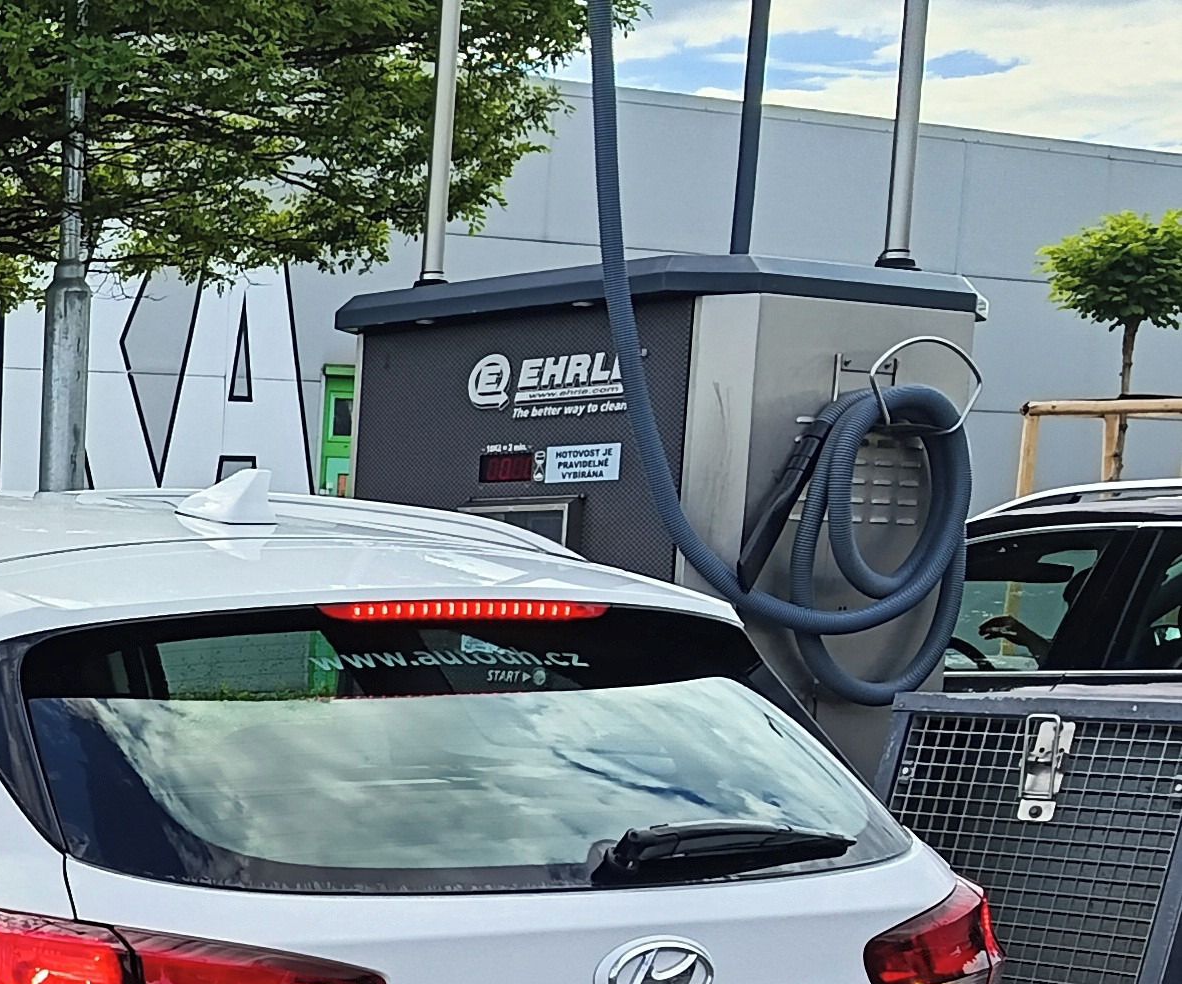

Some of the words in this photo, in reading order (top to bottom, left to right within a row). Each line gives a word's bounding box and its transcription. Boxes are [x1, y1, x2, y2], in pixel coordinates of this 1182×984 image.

[512, 407, 528, 418] The
[531, 405, 561, 417] better
[563, 404, 585, 417] way
[587, 402, 598, 413] to
[555, 449, 600, 459] HOTOVOST
[602, 448, 613, 457] JE
[557, 458, 609, 470] PRAVIDELNÉ
[561, 468, 604, 480] VYBÍRÁNA
[486, 669, 521, 683] START
